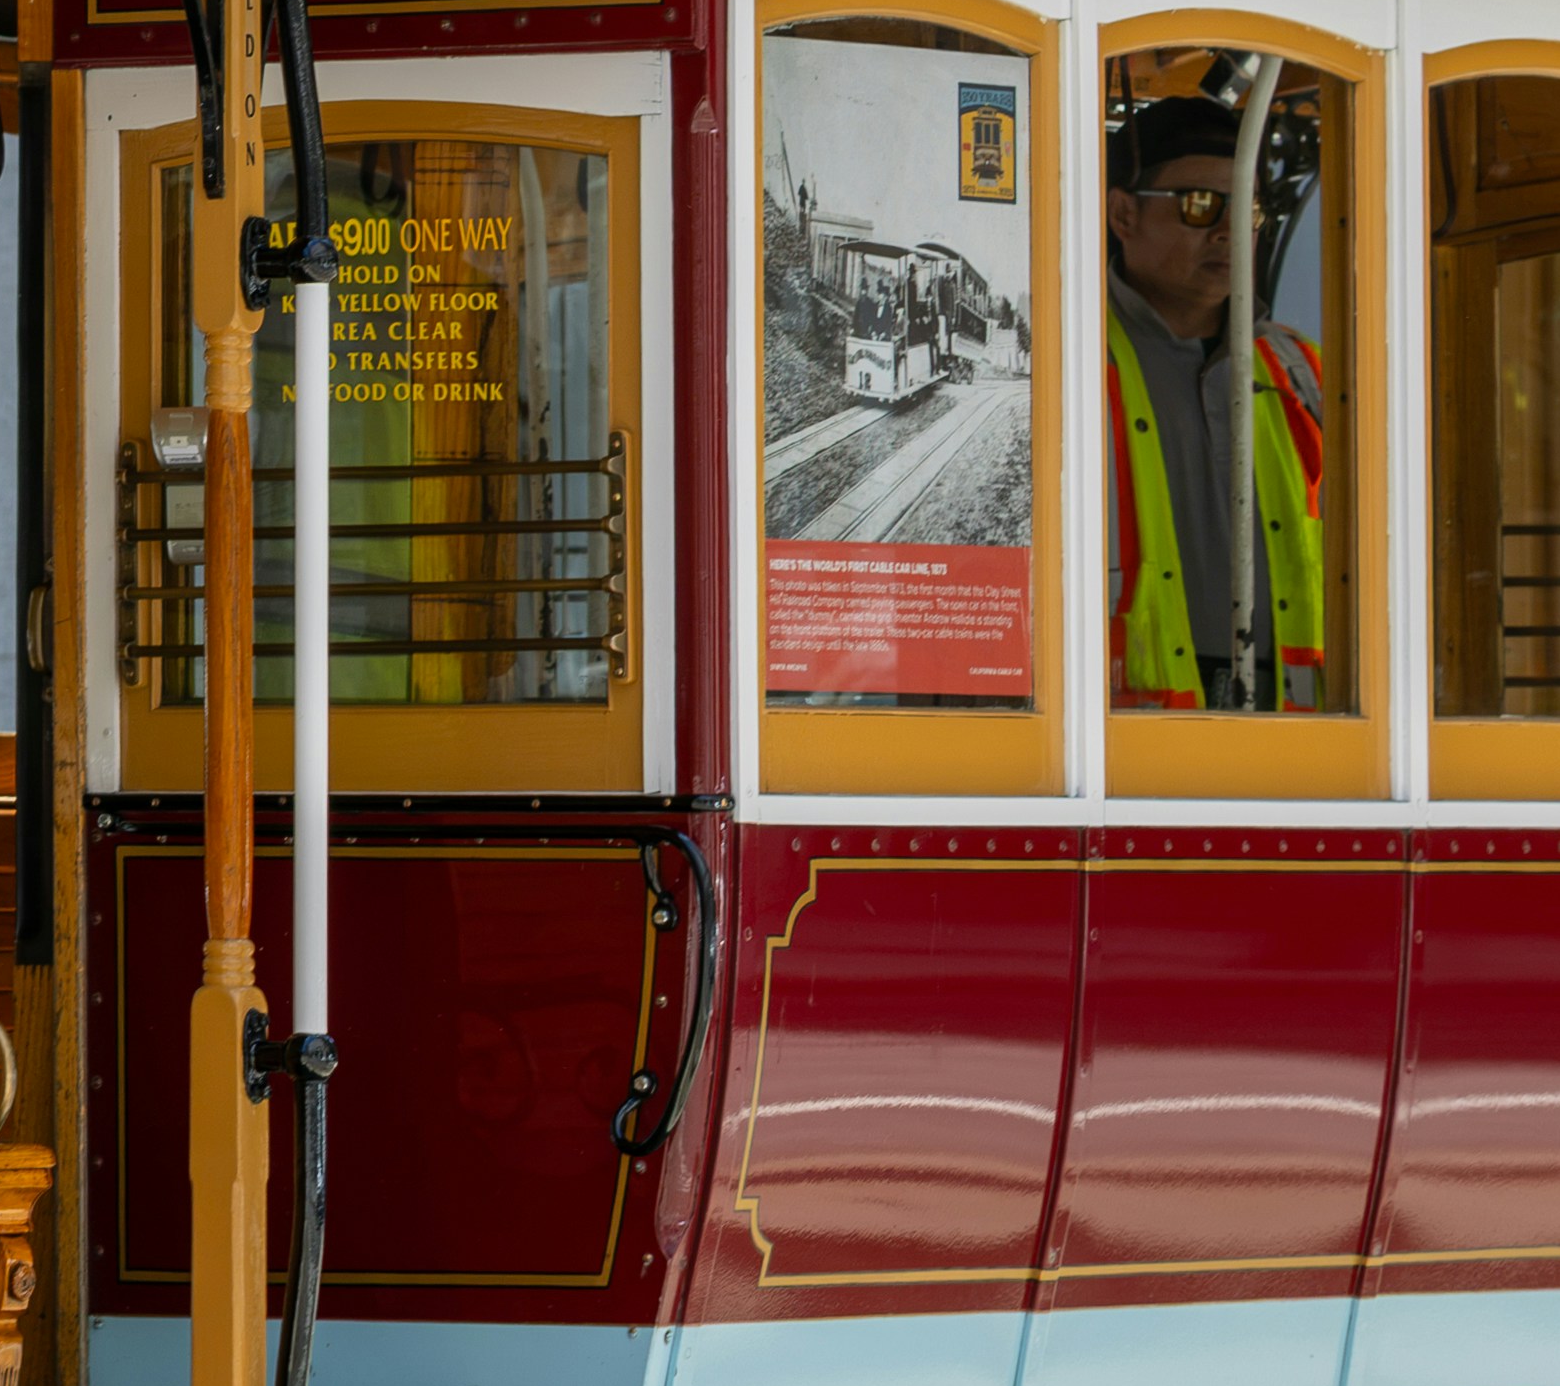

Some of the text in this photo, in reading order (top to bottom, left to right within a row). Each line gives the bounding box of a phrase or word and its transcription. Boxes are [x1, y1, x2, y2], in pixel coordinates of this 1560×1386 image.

[245, 94, 256, 167] ON
[329, 218, 390, 256] $9.00
[400, 218, 453, 254] ONE
[458, 216, 513, 251] WAY
[338, 264, 441, 285] HOLD ON
[337, 292, 499, 313] YELLOW FLOOR
[333, 321, 463, 341] REA CLEAR
[347, 351, 478, 371] TRANSFERS
[393, 382, 425, 402] OR
[433, 382, 504, 402] DRINK
